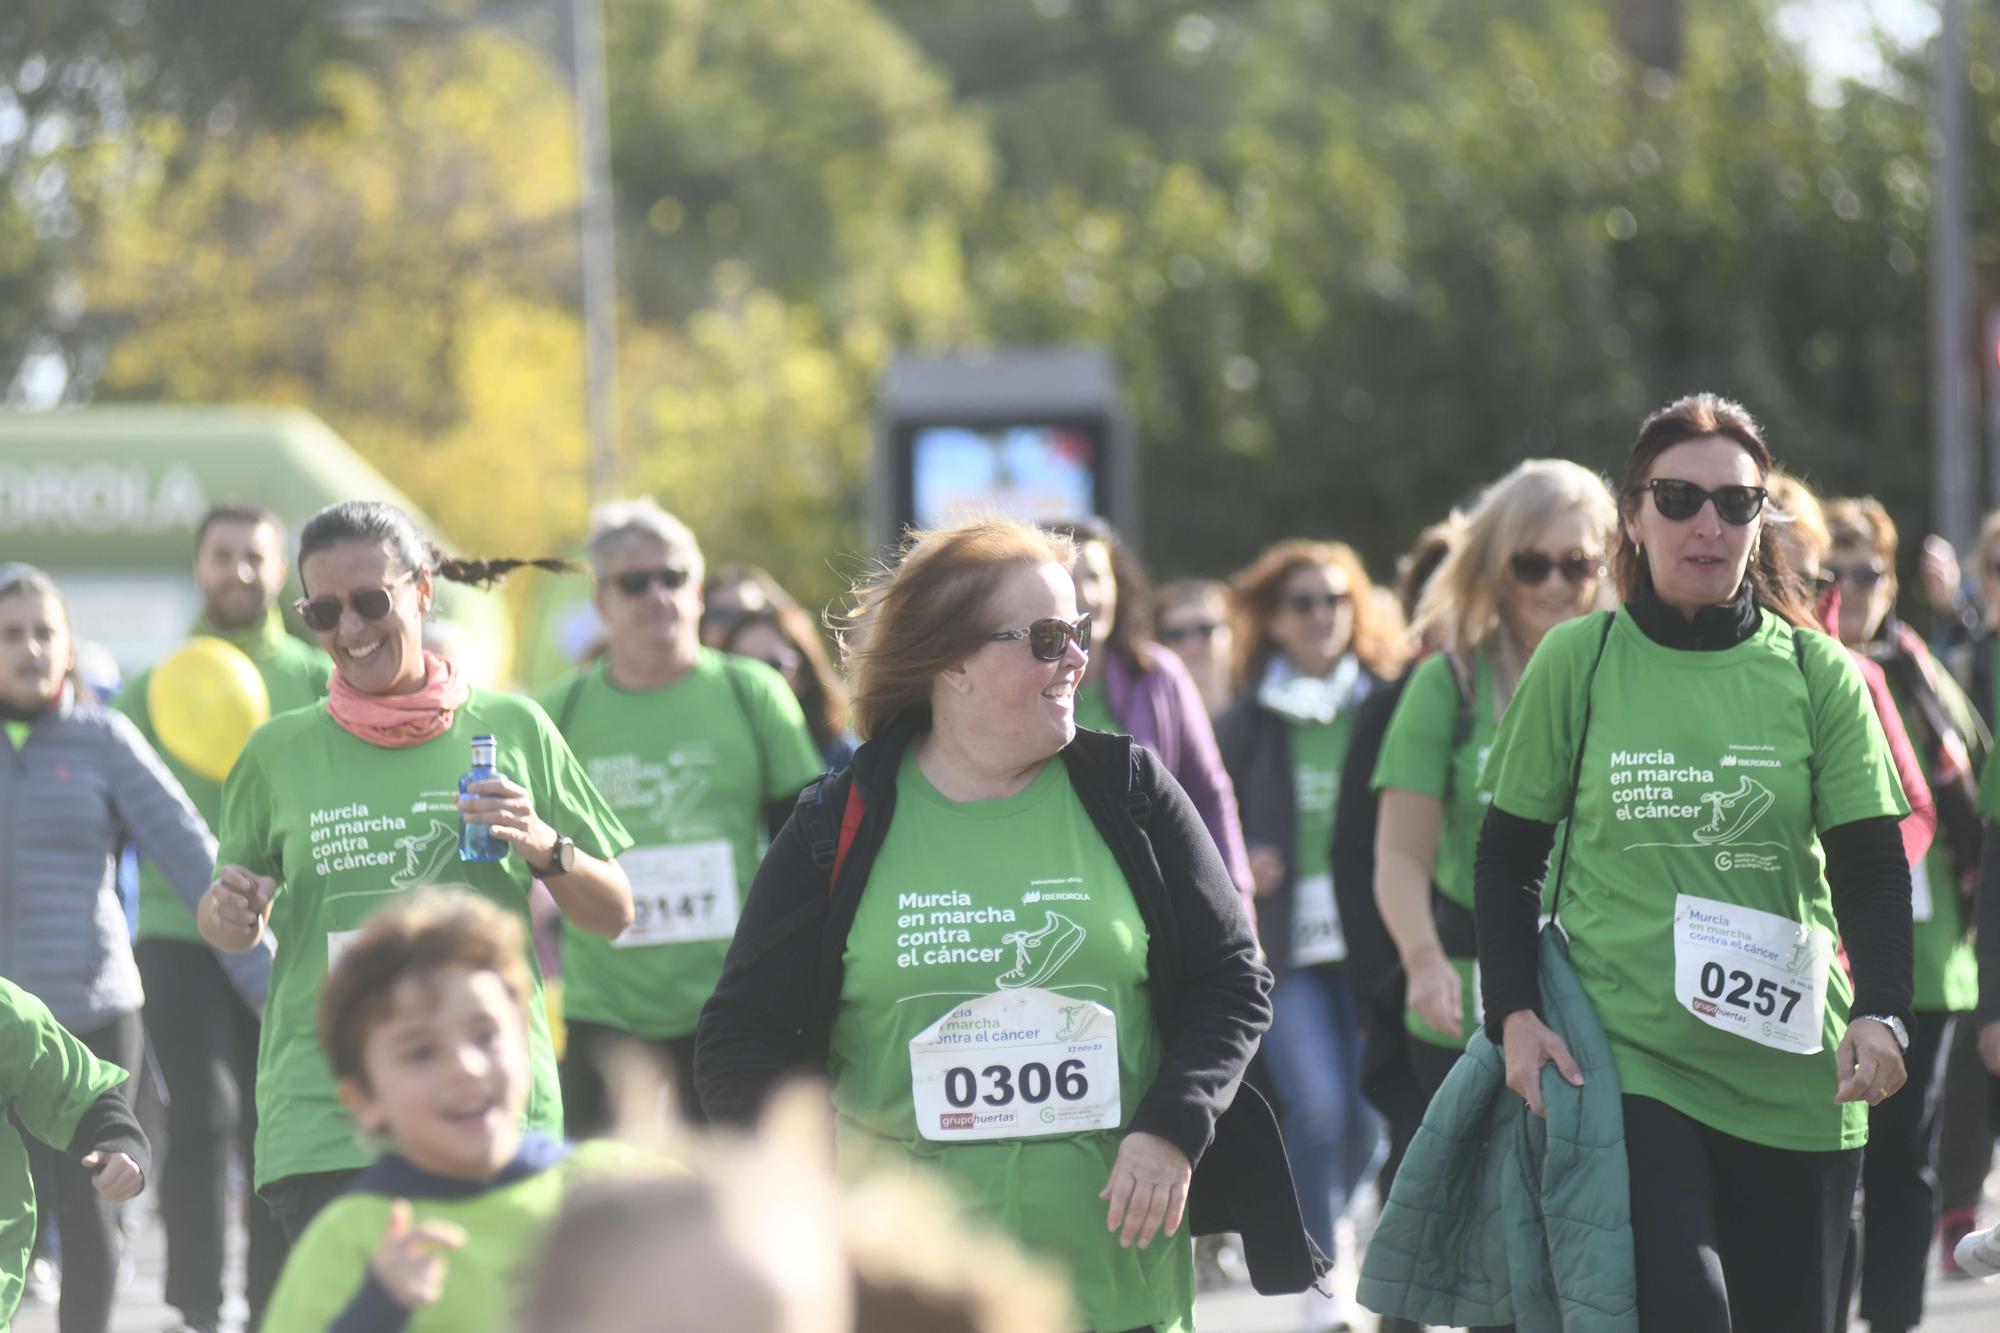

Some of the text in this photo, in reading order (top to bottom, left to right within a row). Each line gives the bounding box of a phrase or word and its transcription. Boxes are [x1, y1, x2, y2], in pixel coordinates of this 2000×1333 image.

[0, 464, 206, 532] DROLA
[1610, 749, 1675, 768] Murcia
[1610, 767, 1714, 785] en marcha
[1612, 786, 1673, 803] contra
[310, 802, 368, 827] Murcia
[1616, 801, 1702, 821] el cáncer
[310, 815, 406, 843] en marcha
[312, 836, 368, 859] contra
[316, 850, 397, 876] el cáncer
[898, 890, 972, 910] Murcia
[1042, 893, 1091, 901] IBERDROLA
[898, 907, 1016, 928] en marcha
[1690, 910, 1729, 926] Murcia
[897, 928, 971, 947] contra
[1689, 922, 1752, 940] en marcha
[1689, 932, 1779, 961] contra el cáncer
[897, 946, 1004, 968] el cáncer
[1701, 961, 1802, 1024] 0257
[952, 1008, 972, 1019] cia
[947, 1018, 1000, 1031] marcha
[930, 1028, 1040, 1045] ontra el cáncer
[944, 1059, 1089, 1109] 0306
